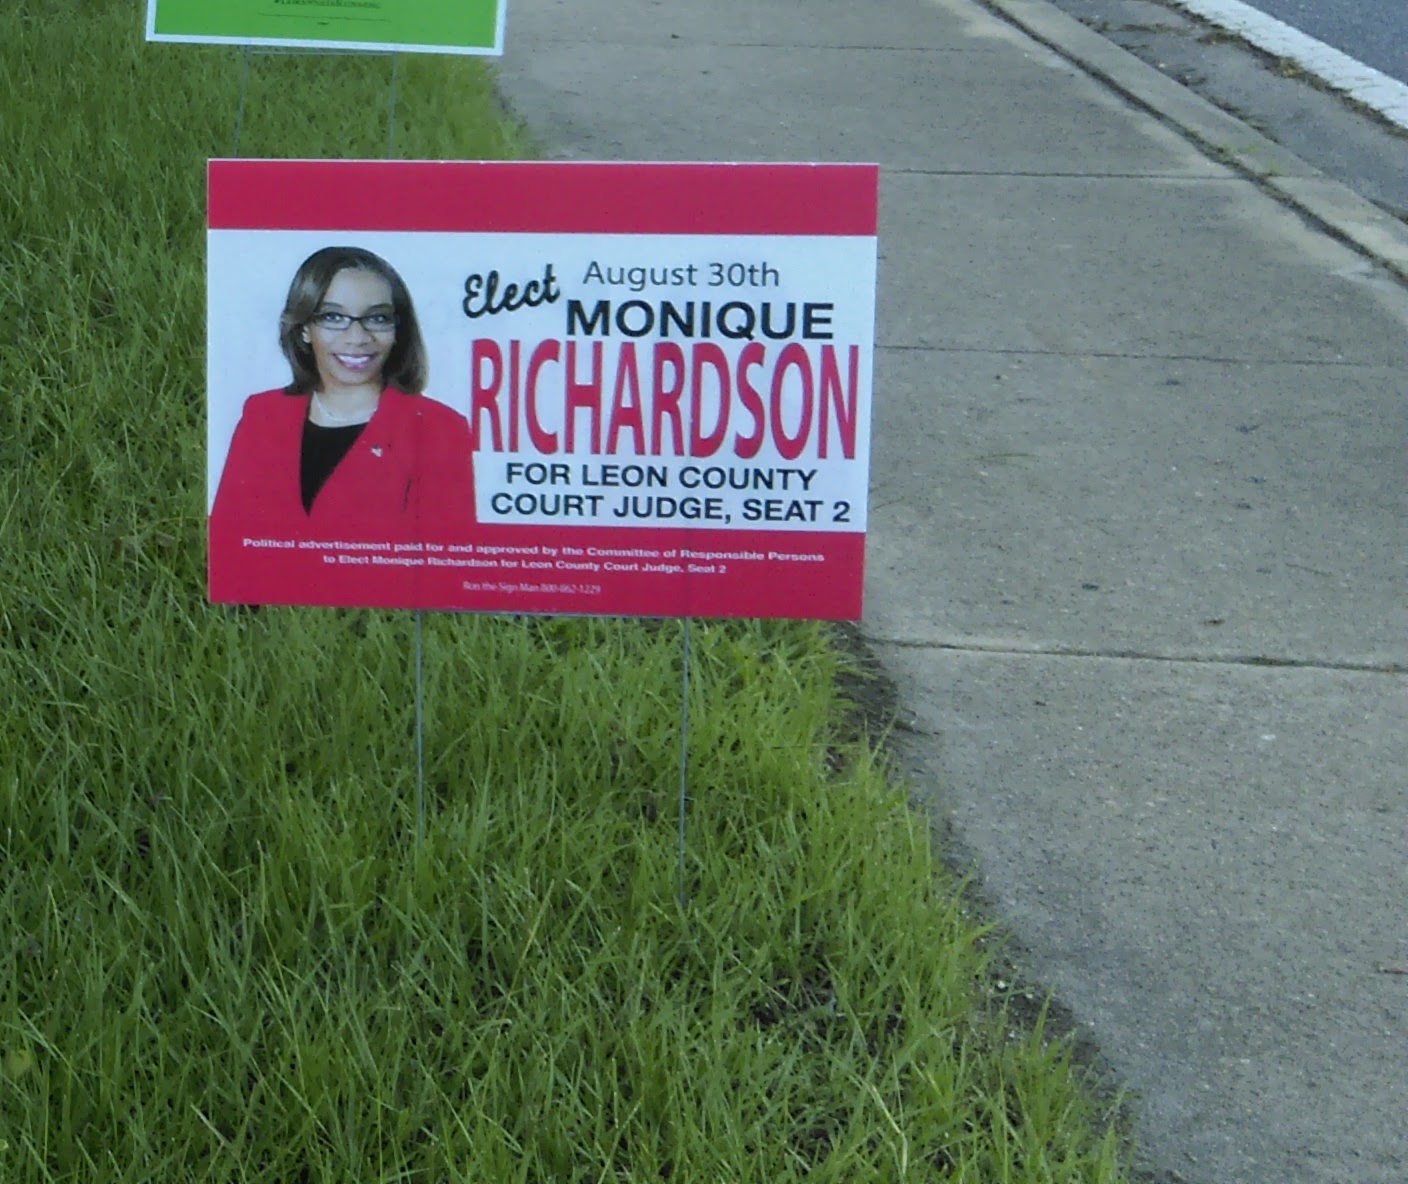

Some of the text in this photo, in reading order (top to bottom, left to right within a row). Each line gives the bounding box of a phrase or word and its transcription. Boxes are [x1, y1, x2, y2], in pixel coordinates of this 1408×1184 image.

[582, 260, 779, 291] August 30th
[462, 264, 835, 341] Elect MONIQUE
[471, 338, 859, 460] RICHARDSON
[506, 462, 818, 491] FOR LEON COUNTY
[491, 492, 850, 525] COURT JUDGE, SEAT 2
[243, 537, 825, 562] Political advertisement paid for and approved by the Committee of Responsible Persons
[323, 554, 336, 564] to
[338, 554, 369, 564] Elect
[372, 555, 424, 567] Monique
[427, 556, 498, 567] Richardson
[501, 558, 518, 568] for
[521, 559, 553, 569] Leon
[555, 560, 600, 572] County
[603, 561, 639, 571] Court
[687, 563, 715, 573] Seat
[719, 564, 727, 574] 2
